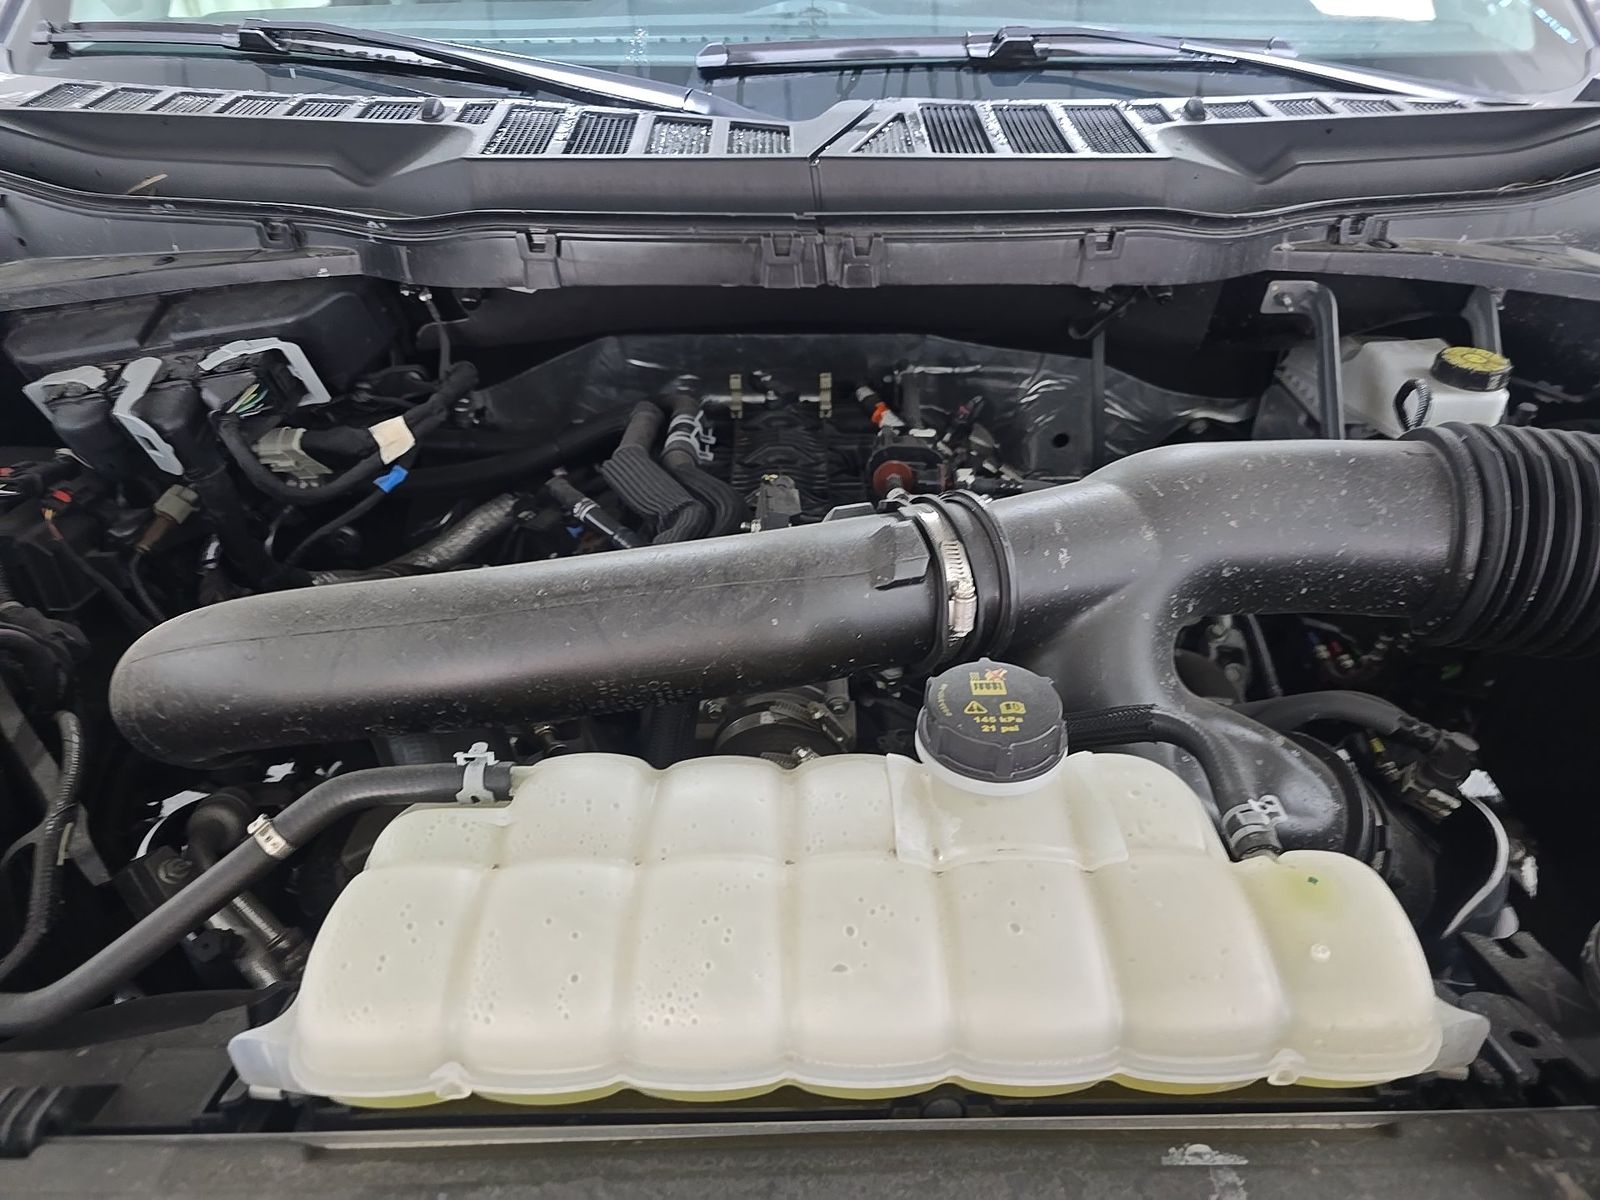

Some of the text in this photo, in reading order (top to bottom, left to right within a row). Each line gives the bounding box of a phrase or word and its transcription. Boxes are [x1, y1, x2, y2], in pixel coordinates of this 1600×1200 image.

[973, 715, 1024, 723] 145 kPa
[981, 724, 1020, 733] 21 psi
